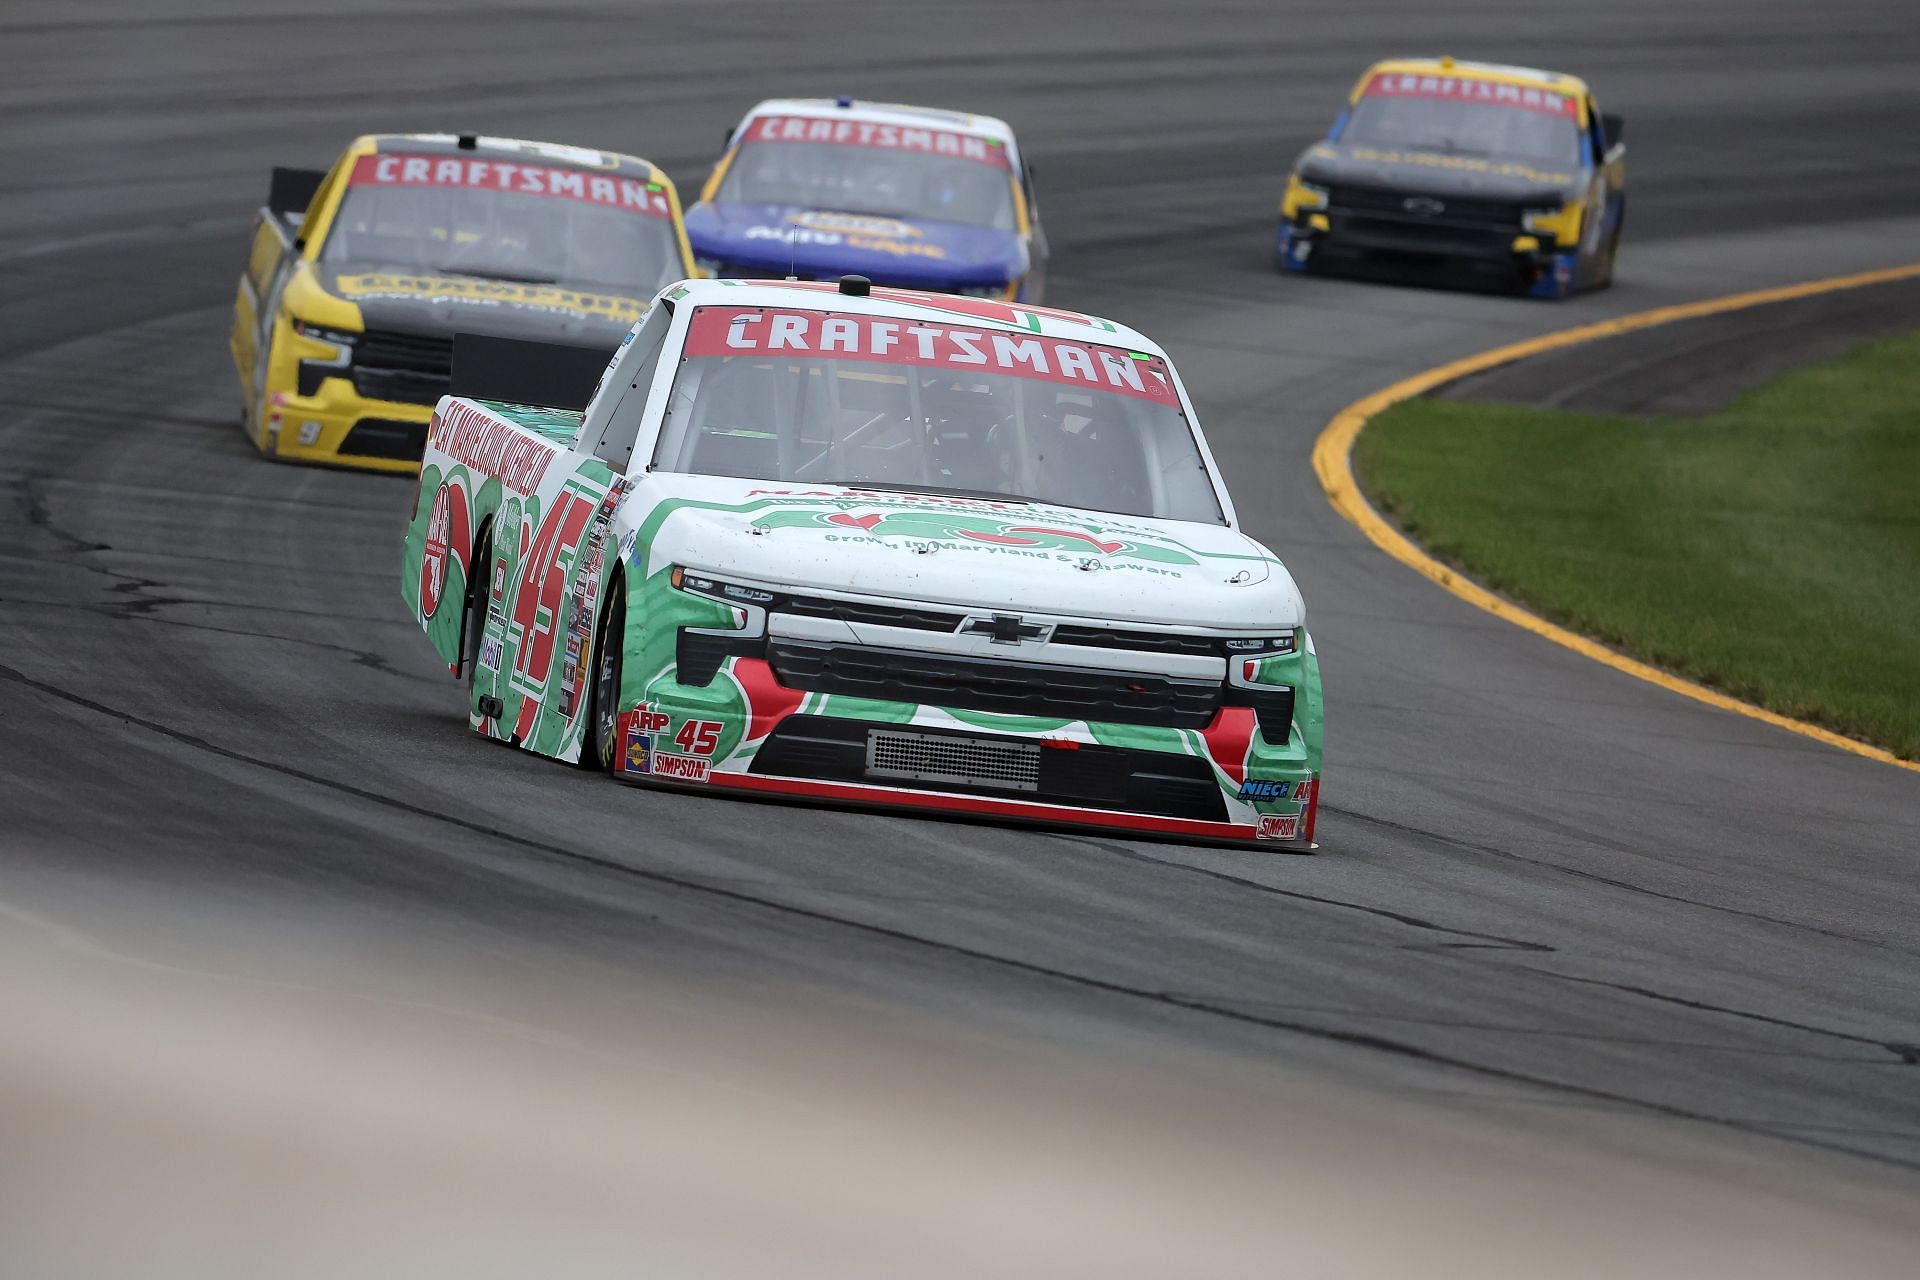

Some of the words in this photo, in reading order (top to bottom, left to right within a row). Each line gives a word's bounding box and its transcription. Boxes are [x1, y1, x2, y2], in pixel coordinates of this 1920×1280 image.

[1381, 75, 1563, 111] CRAFTSMAN
[761, 117, 987, 158] CRAFTSMAN
[375, 157, 649, 210] CRAFTSMAN
[726, 313, 1147, 393] CRAFTSMAN
[824, 534, 899, 550] Grown
[932, 541, 1050, 560] Maryland
[1056, 554, 1073, 562] &
[513, 488, 596, 684] 45
[630, 711, 670, 731] ARP
[674, 719, 725, 755] 45
[655, 755, 706, 779] SIMPSON
